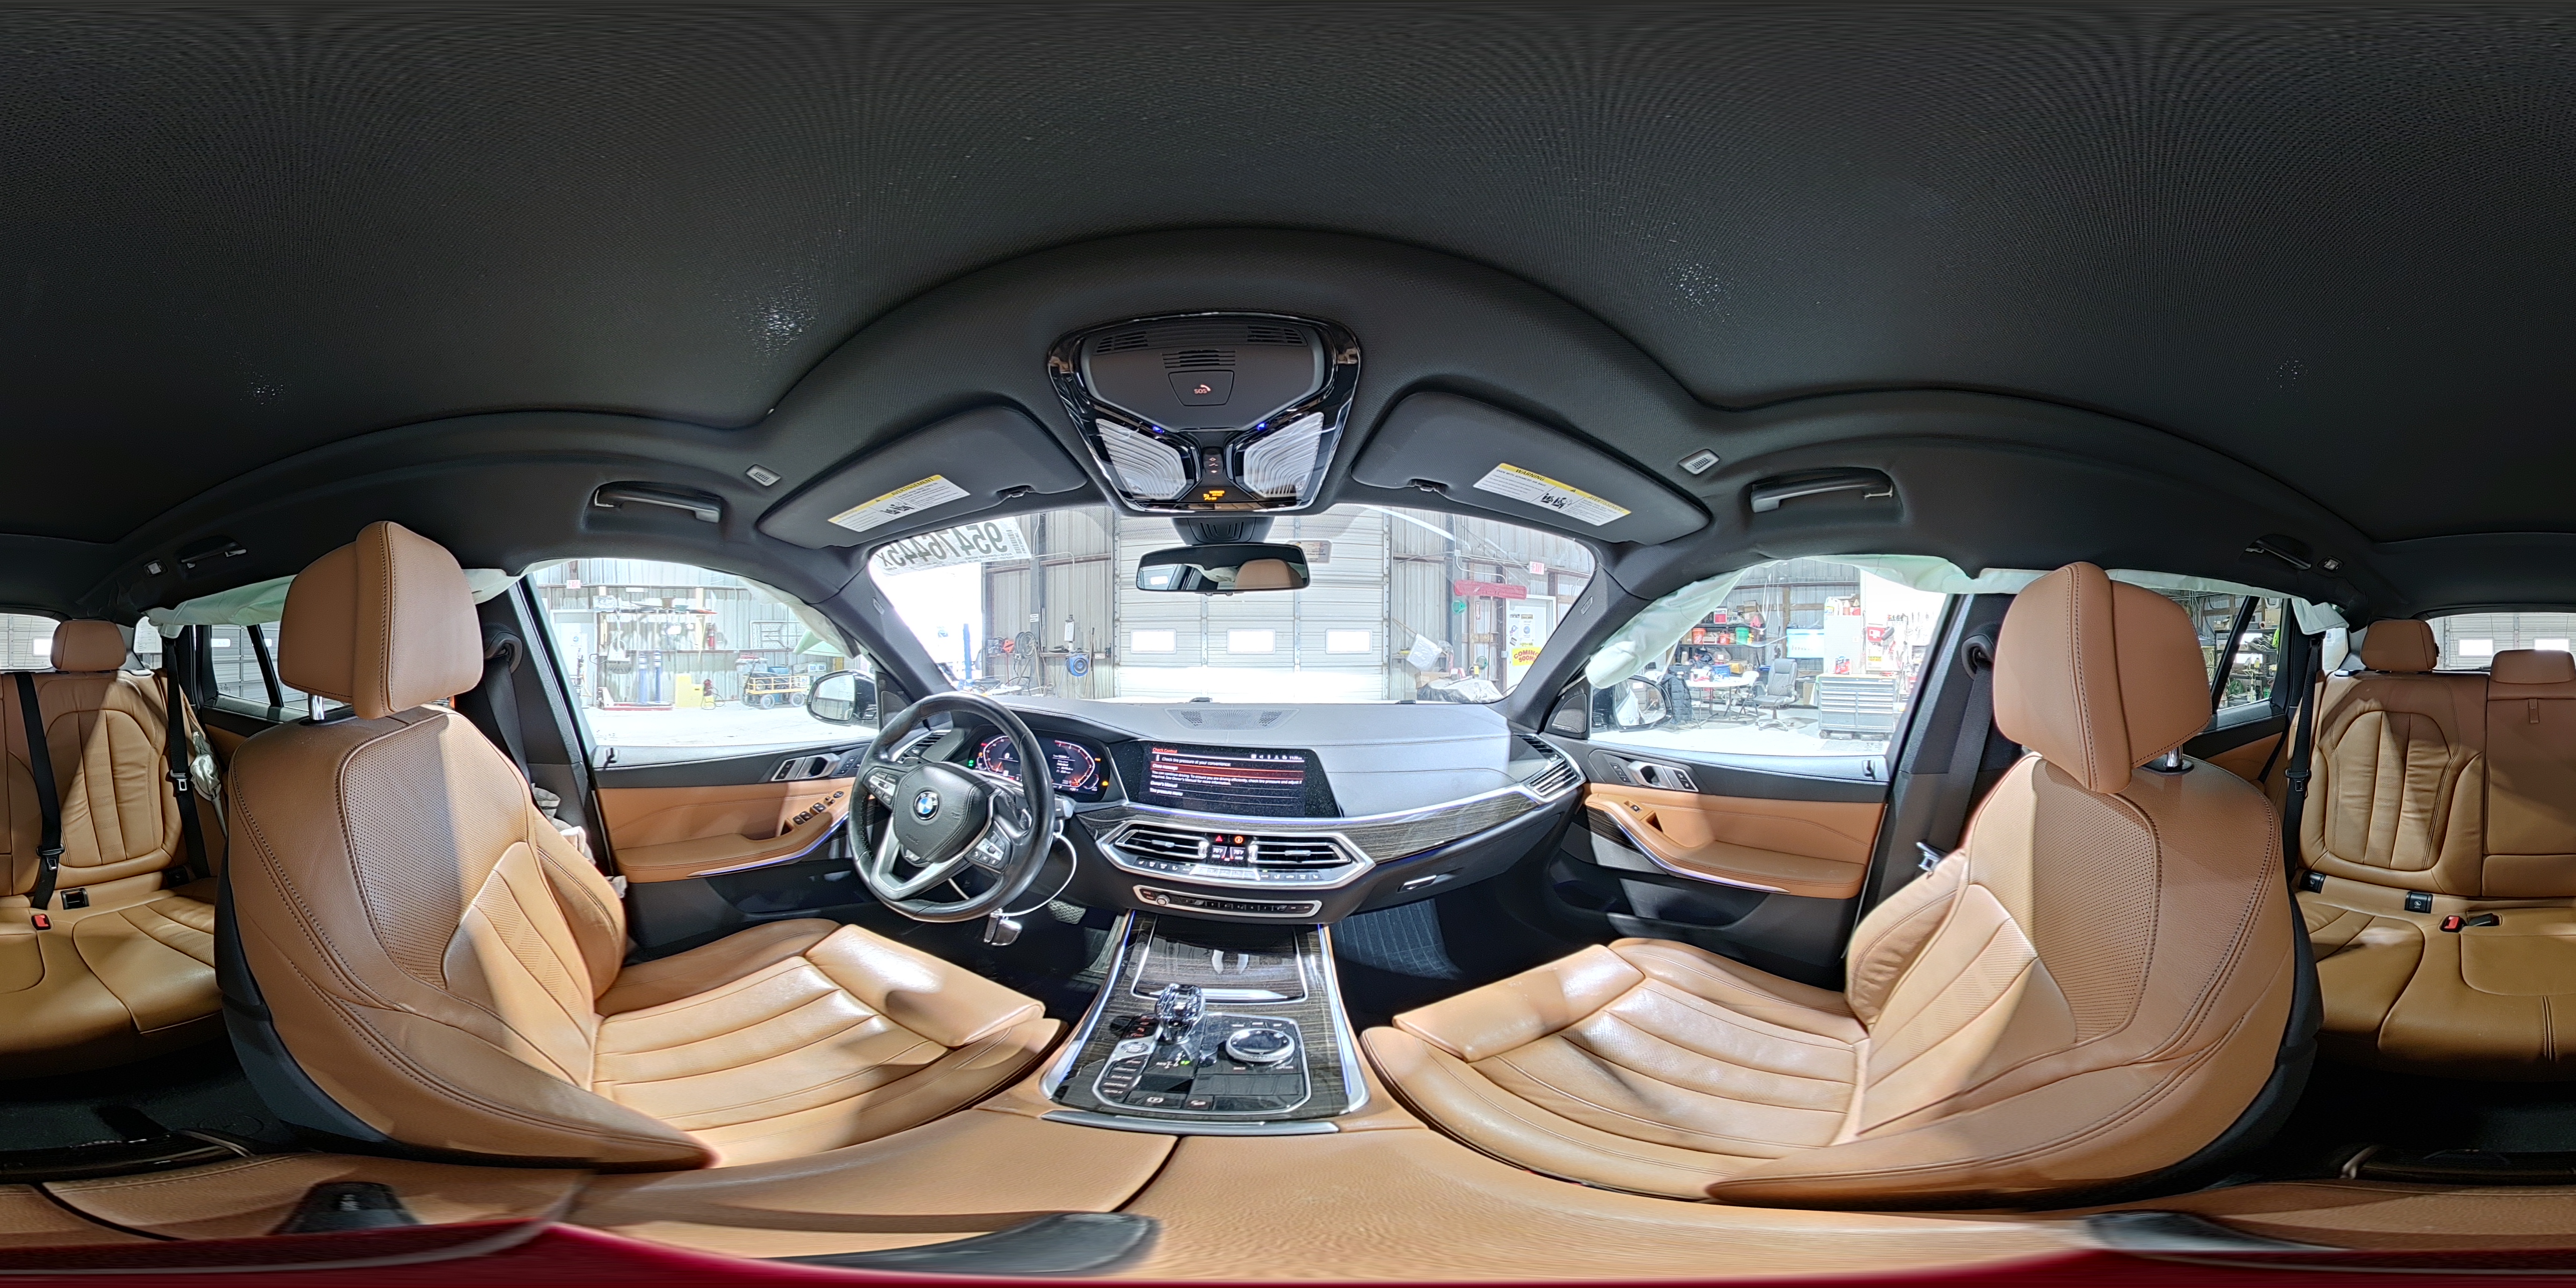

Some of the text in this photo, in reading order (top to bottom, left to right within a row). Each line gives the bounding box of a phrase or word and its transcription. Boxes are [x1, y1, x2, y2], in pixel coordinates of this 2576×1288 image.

[1515, 468, 1545, 481] WARNING
[891, 477, 934, 496] AVERTISSEMENT
[1588, 496, 1625, 512] AVERTISSEMENT
[1532, 563, 1543, 573] EXIT
